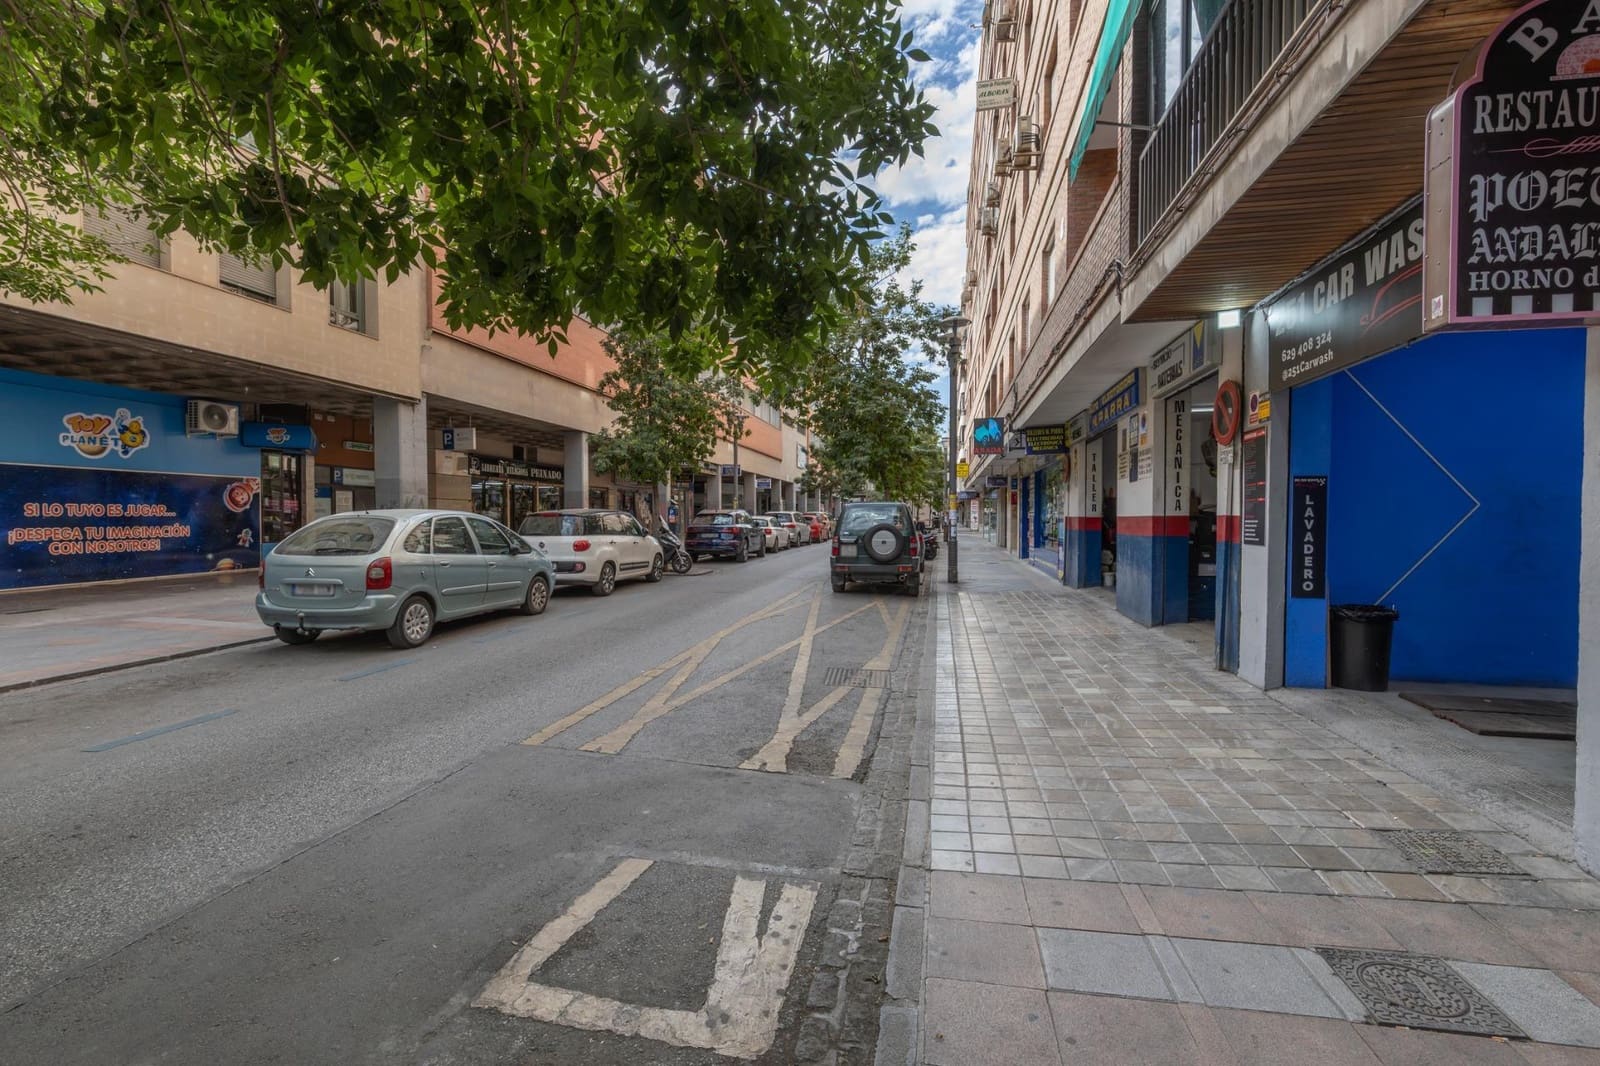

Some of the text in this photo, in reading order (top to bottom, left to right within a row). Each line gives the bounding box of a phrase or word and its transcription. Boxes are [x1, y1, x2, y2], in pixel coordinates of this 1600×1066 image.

[1467, 222, 1600, 264] ANDAL
[1313, 262, 1354, 314] CAR
[1468, 267, 1574, 291] HORNO
[1281, 330, 1332, 362] 629 408 324
[1281, 348, 1334, 381] @251Carwash
[65, 414, 112, 435] TOY
[1174, 400, 1185, 512] MECANICA
[24, 503, 39, 517] SI
[42, 503, 63, 517] LO
[66, 503, 105, 517] TUYO
[107, 504, 122, 517] ES
[8, 524, 190, 545] ¡DESPEGA TU IMAGINACIÓN
[49, 539, 161, 555] CON NOSOTROS!
[1302, 494, 1314, 591] LAVADERO
